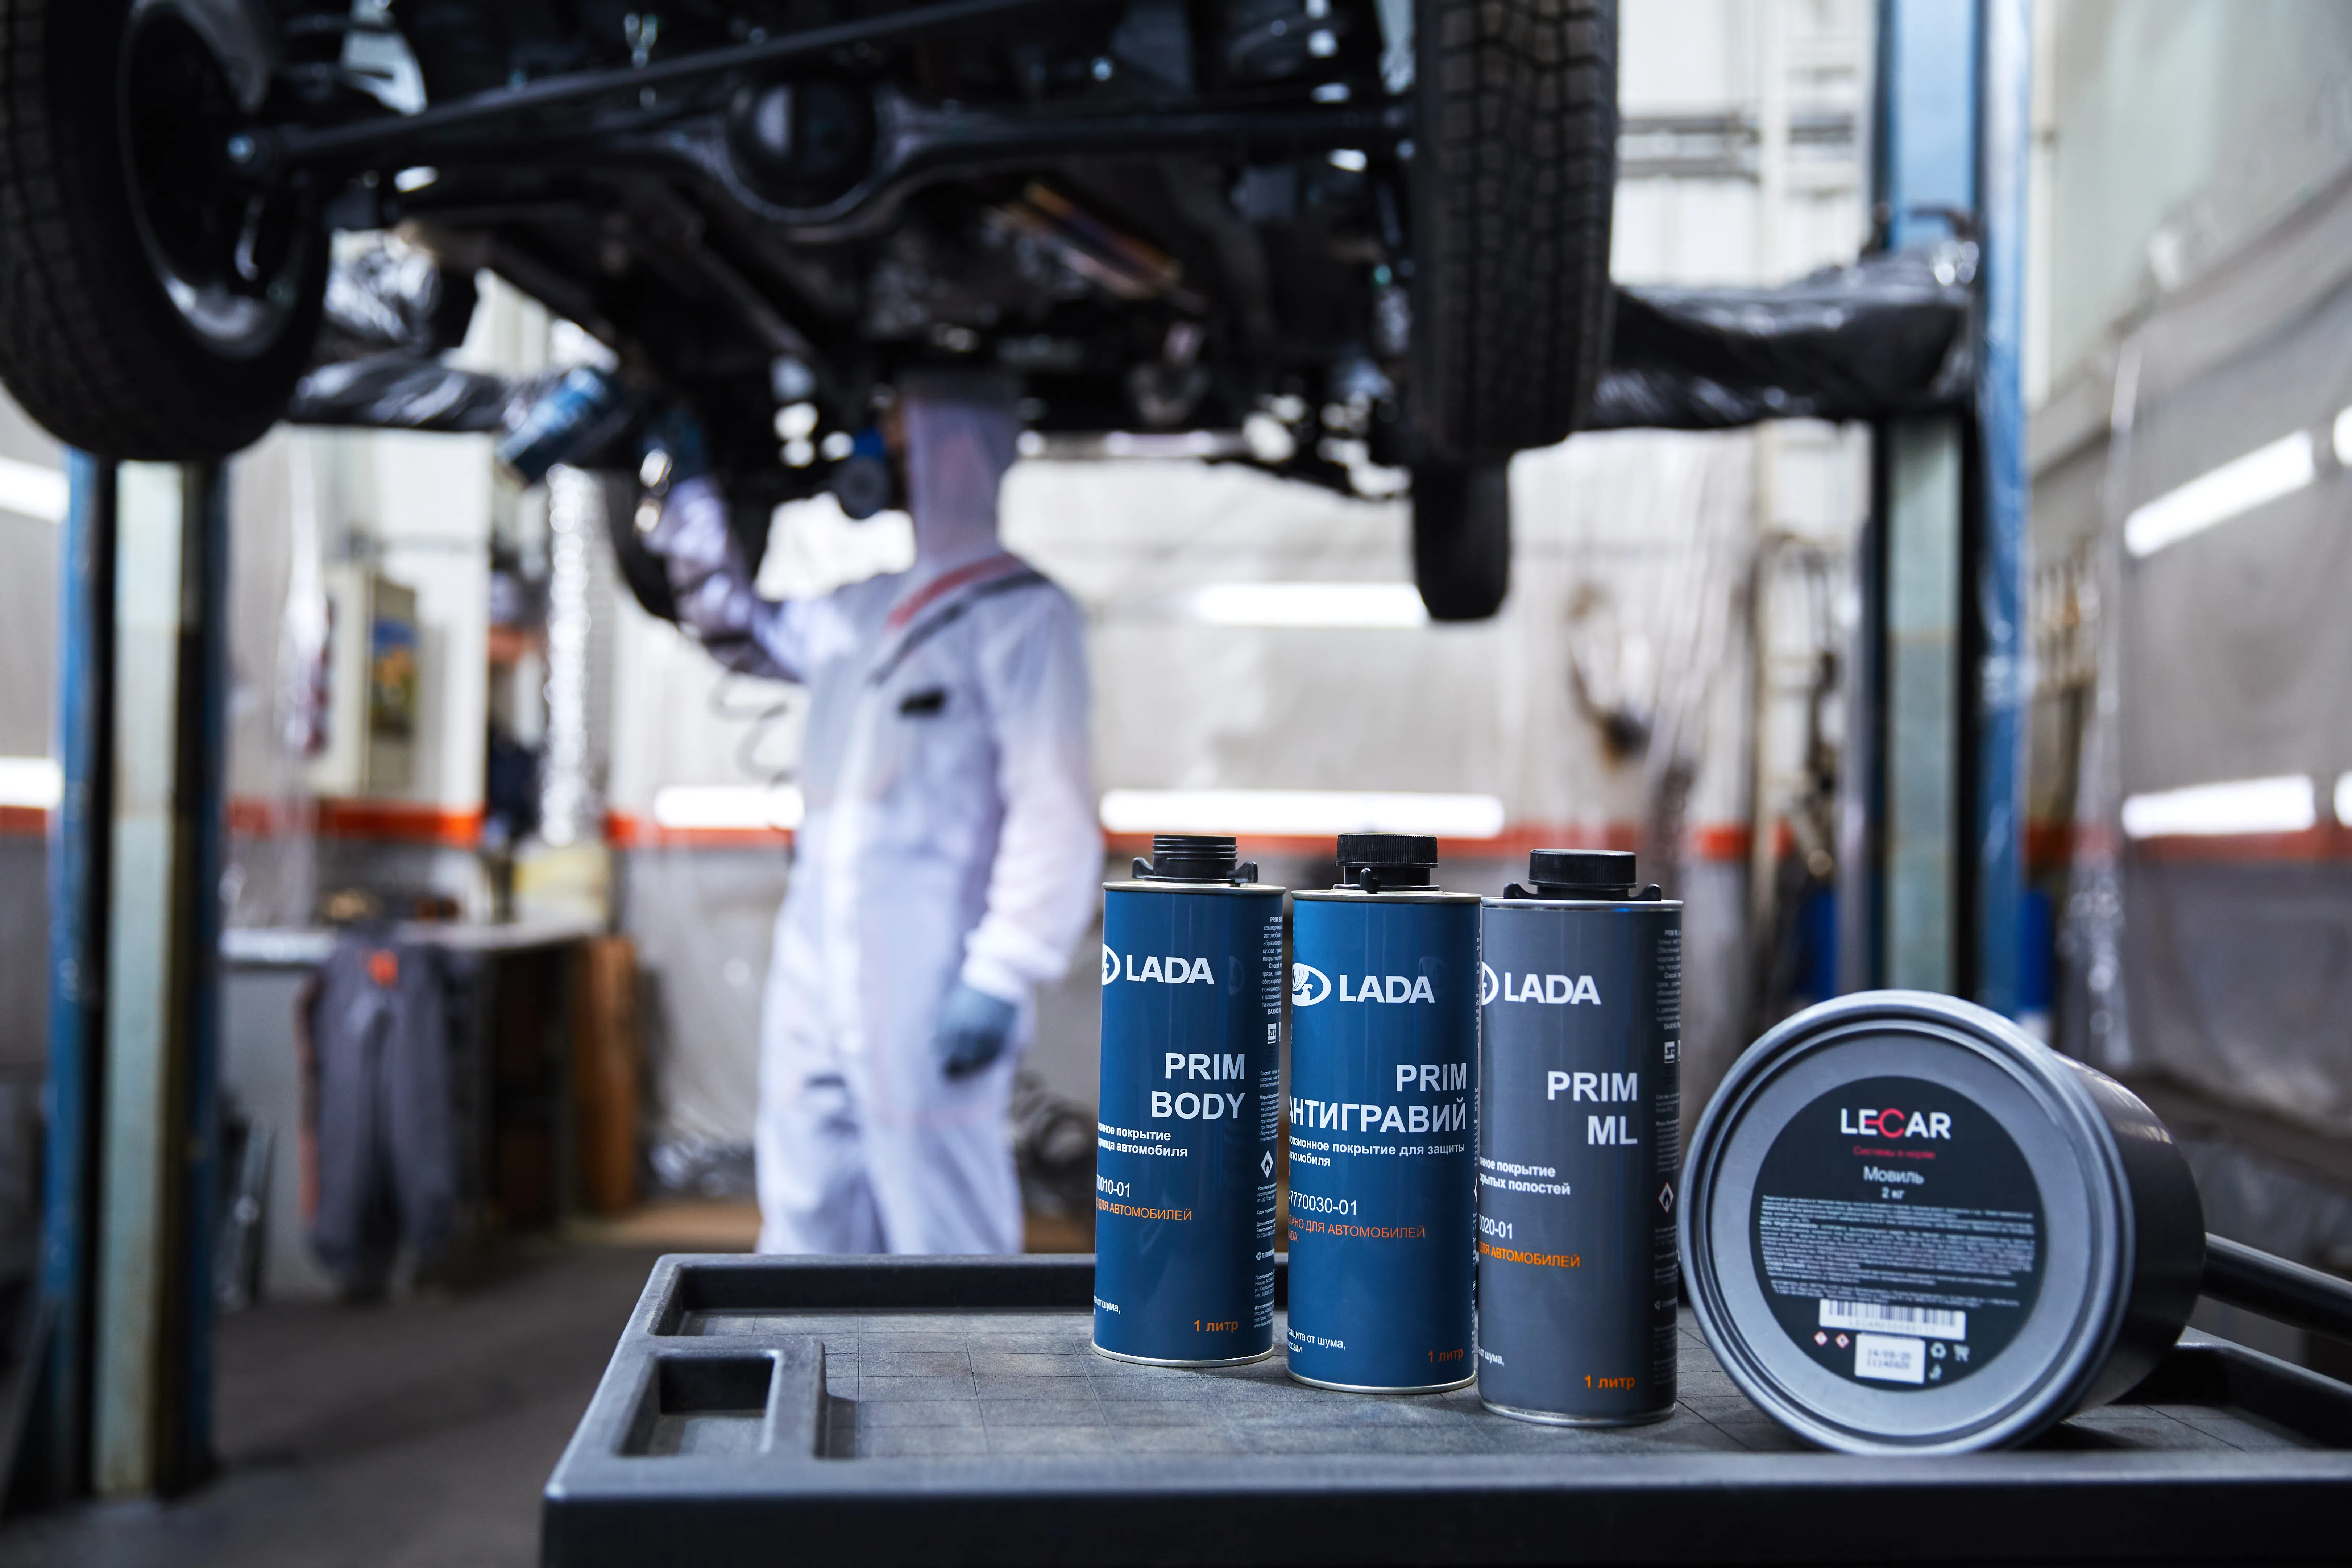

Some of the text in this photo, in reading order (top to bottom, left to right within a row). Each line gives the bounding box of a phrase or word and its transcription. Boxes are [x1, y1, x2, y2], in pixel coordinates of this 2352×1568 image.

[1126, 954, 1215, 984] LADA
[1340, 974, 1435, 1003] LADA
[1504, 972, 1601, 1005] LADA
[1165, 1053, 1245, 1080] PRIM
[1396, 1062, 1467, 1092] PRIM
[1547, 1071, 1638, 1102] PRIM
[1151, 1091, 1245, 1120] BODY
[1116, 1127, 1171, 1141] покрытие
[1588, 1115, 1638, 1145] ML
[1840, 1108, 1952, 1140] LECAR
[1116, 1142, 1187, 1157] автомобиля
[1332, 1143, 1396, 1156] покрытие
[1399, 1145, 1424, 1157] для
[1427, 1142, 1465, 1155] защиты
[1497, 1161, 1556, 1177] покрытие
[1863, 1165, 1925, 1185] Мовиль
[1508, 1180, 1571, 1195] полостей
[1881, 1186, 1905, 1199] 2 кг
[1099, 1199, 1108, 1212] ДЛЯ
[1109, 1203, 1192, 1220] АВТОМОБИЛЕЙ
[1306, 1220, 1325, 1234] ДЛЯ
[1327, 1225, 1426, 1239] АВТОМОБИЛЕЙ
[1491, 1246, 1580, 1268] АВТОМОБИЛЕЙ
[1102, 1301, 1120, 1314] шума,
[1194, 1319, 1239, 1333] 1 литр
[1289, 1327, 1346, 1351] защита от шума,
[1428, 1348, 1463, 1363] 1 литр
[1485, 1351, 1504, 1366] шума,
[1584, 1375, 1635, 1391] 1 литр
